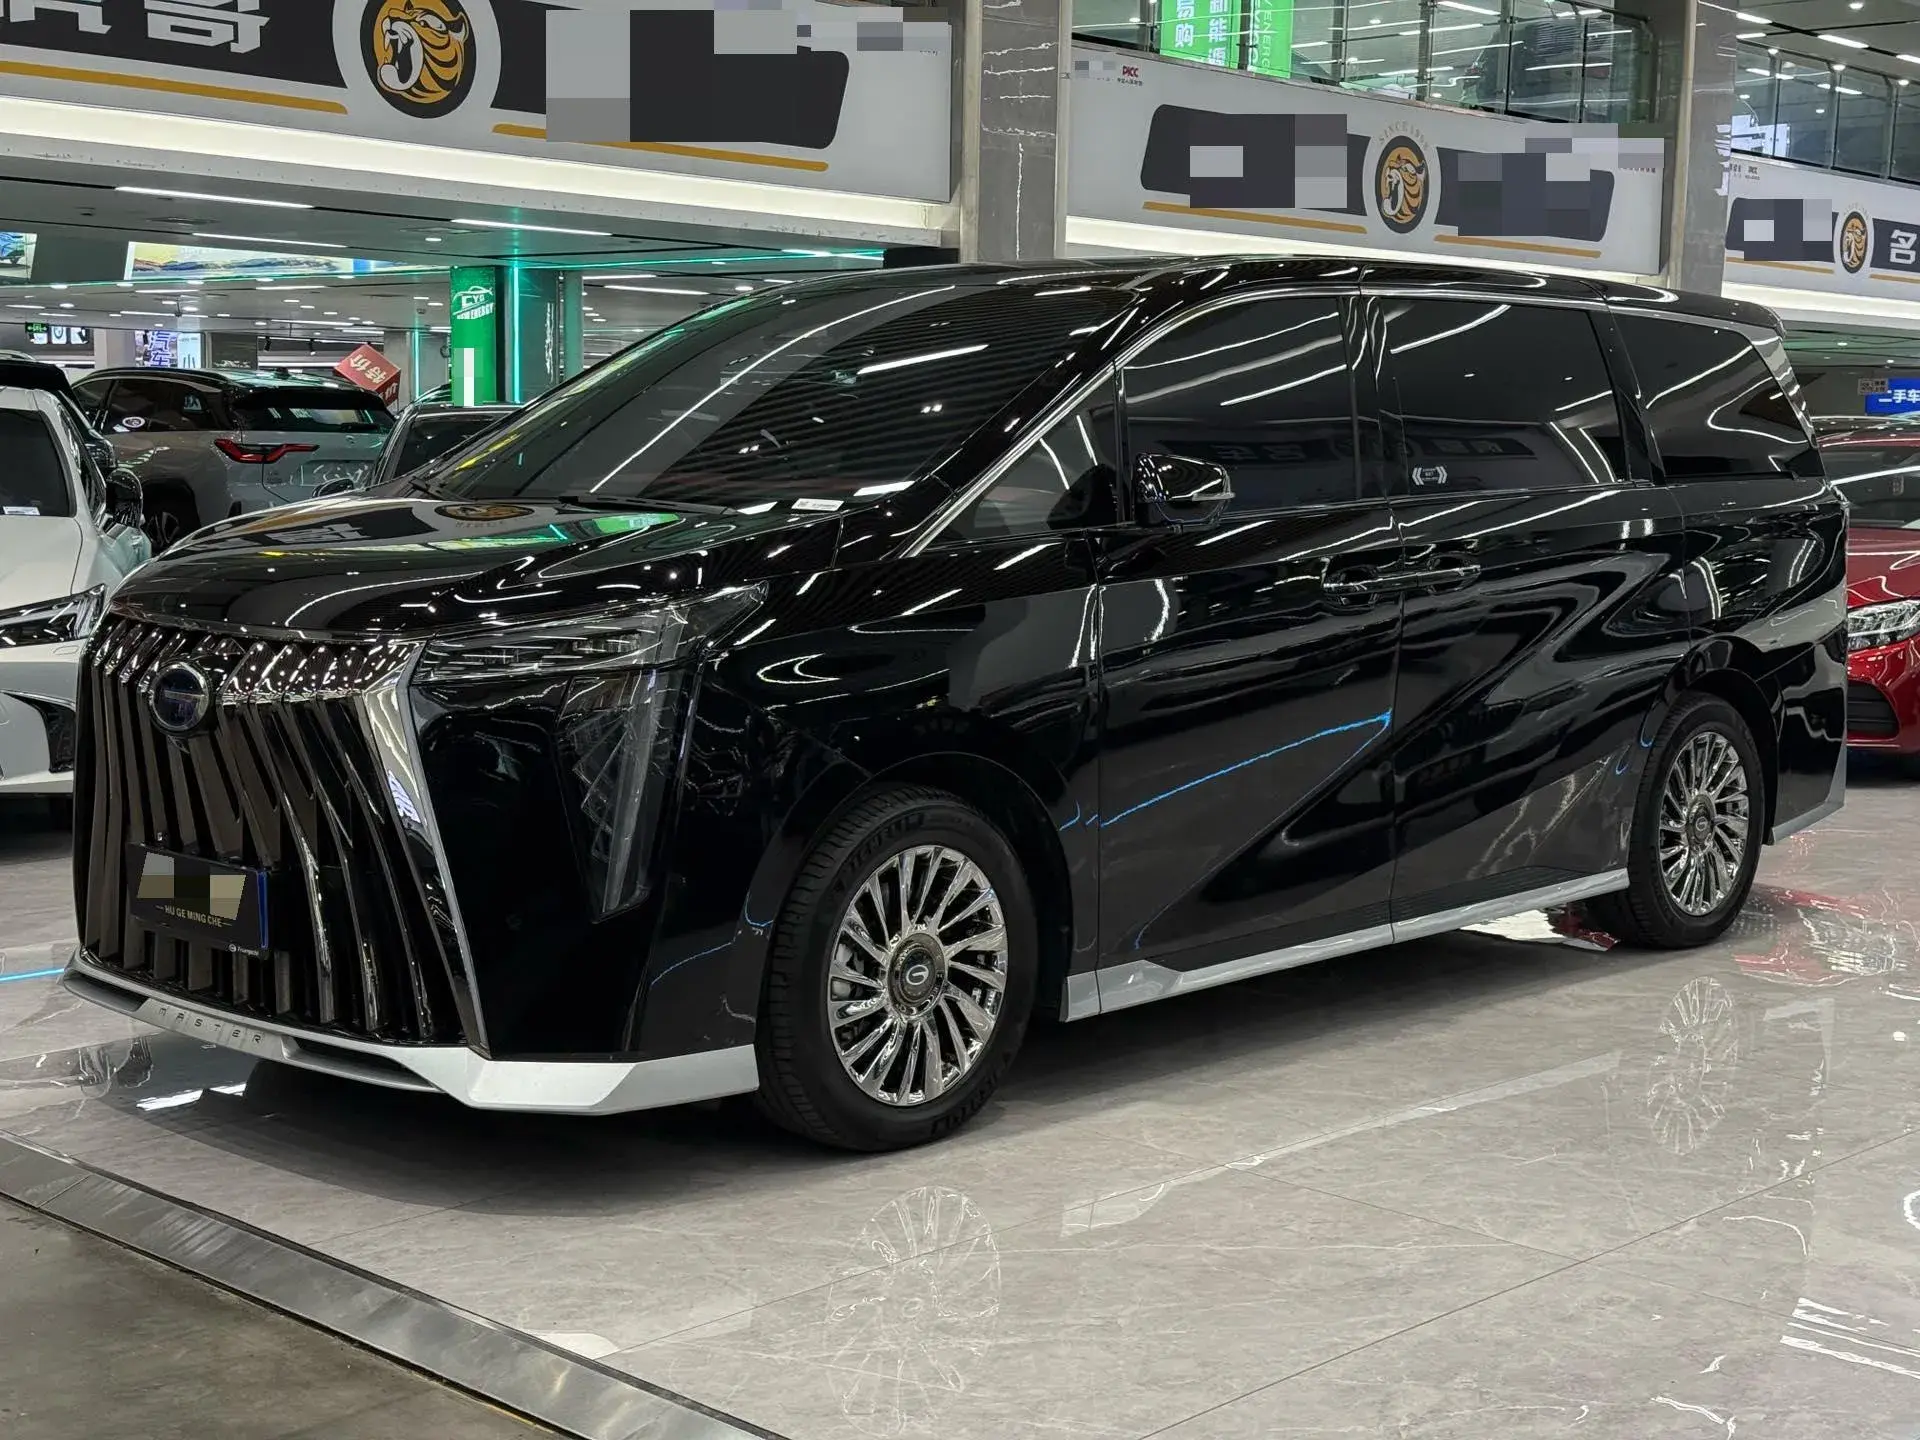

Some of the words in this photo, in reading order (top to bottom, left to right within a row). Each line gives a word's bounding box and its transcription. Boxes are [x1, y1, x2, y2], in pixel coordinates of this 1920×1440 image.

[1122, 65, 1139, 77] PICC
[1890, 229, 1918, 265] 名
[1878, 389, 1920, 404] 二手车
[164, 904, 175, 916] HU
[176, 908, 187, 919] GE
[187, 911, 207, 924] MING
[207, 915, 223, 928] CHE
[159, 1007, 262, 1044] MASTER
